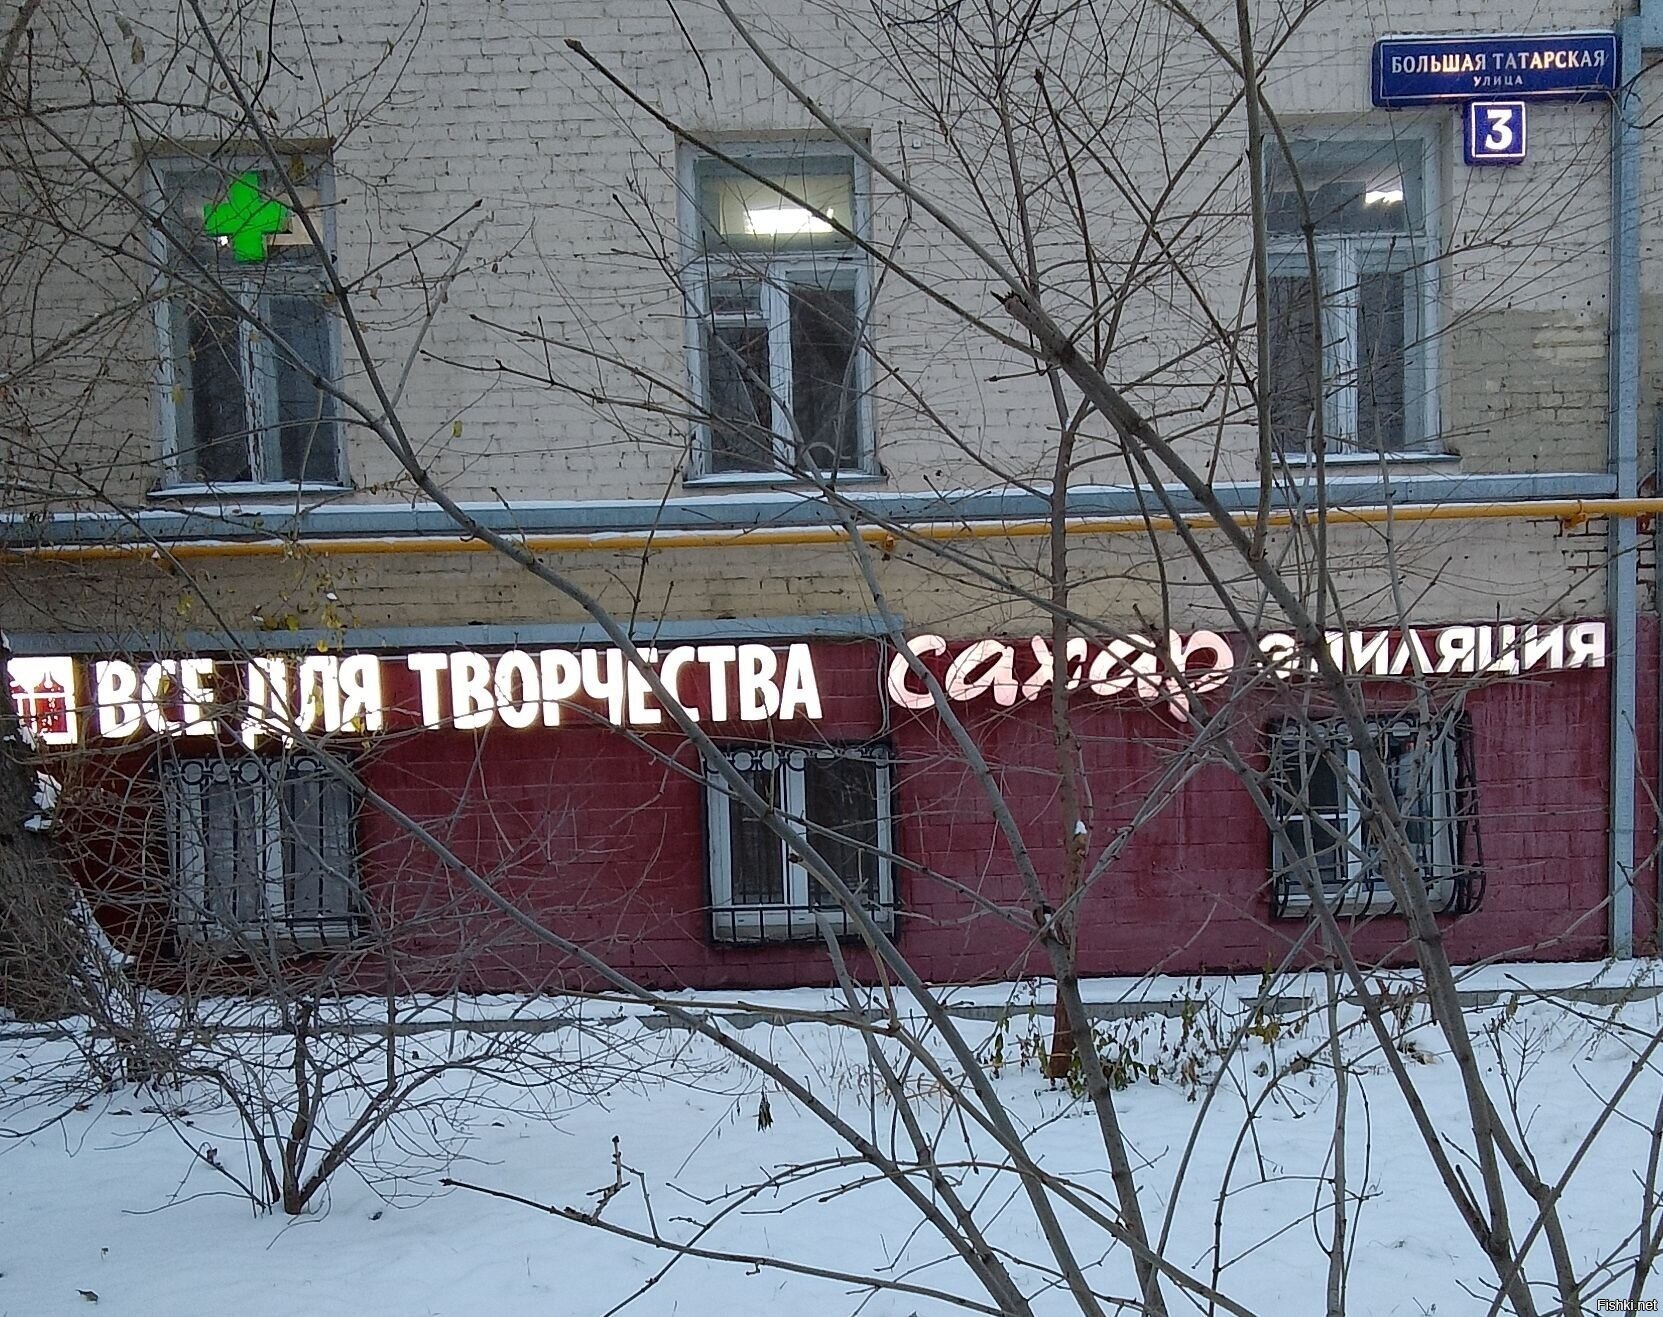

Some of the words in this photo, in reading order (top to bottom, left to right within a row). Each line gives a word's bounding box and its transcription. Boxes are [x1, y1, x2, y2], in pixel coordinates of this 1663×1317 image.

[1391, 51, 1487, 73] БОЛЬШАЯ
[1492, 49, 1606, 70] ТАТАРСКАЯ
[1473, 75, 1524, 87] УЛИЦА
[1485, 109, 1513, 150] 3
[96, 658, 215, 739] ВСЕ
[240, 653, 384, 750] ДЛЯ
[407, 643, 823, 730] ТВОРЧЕСТВА
